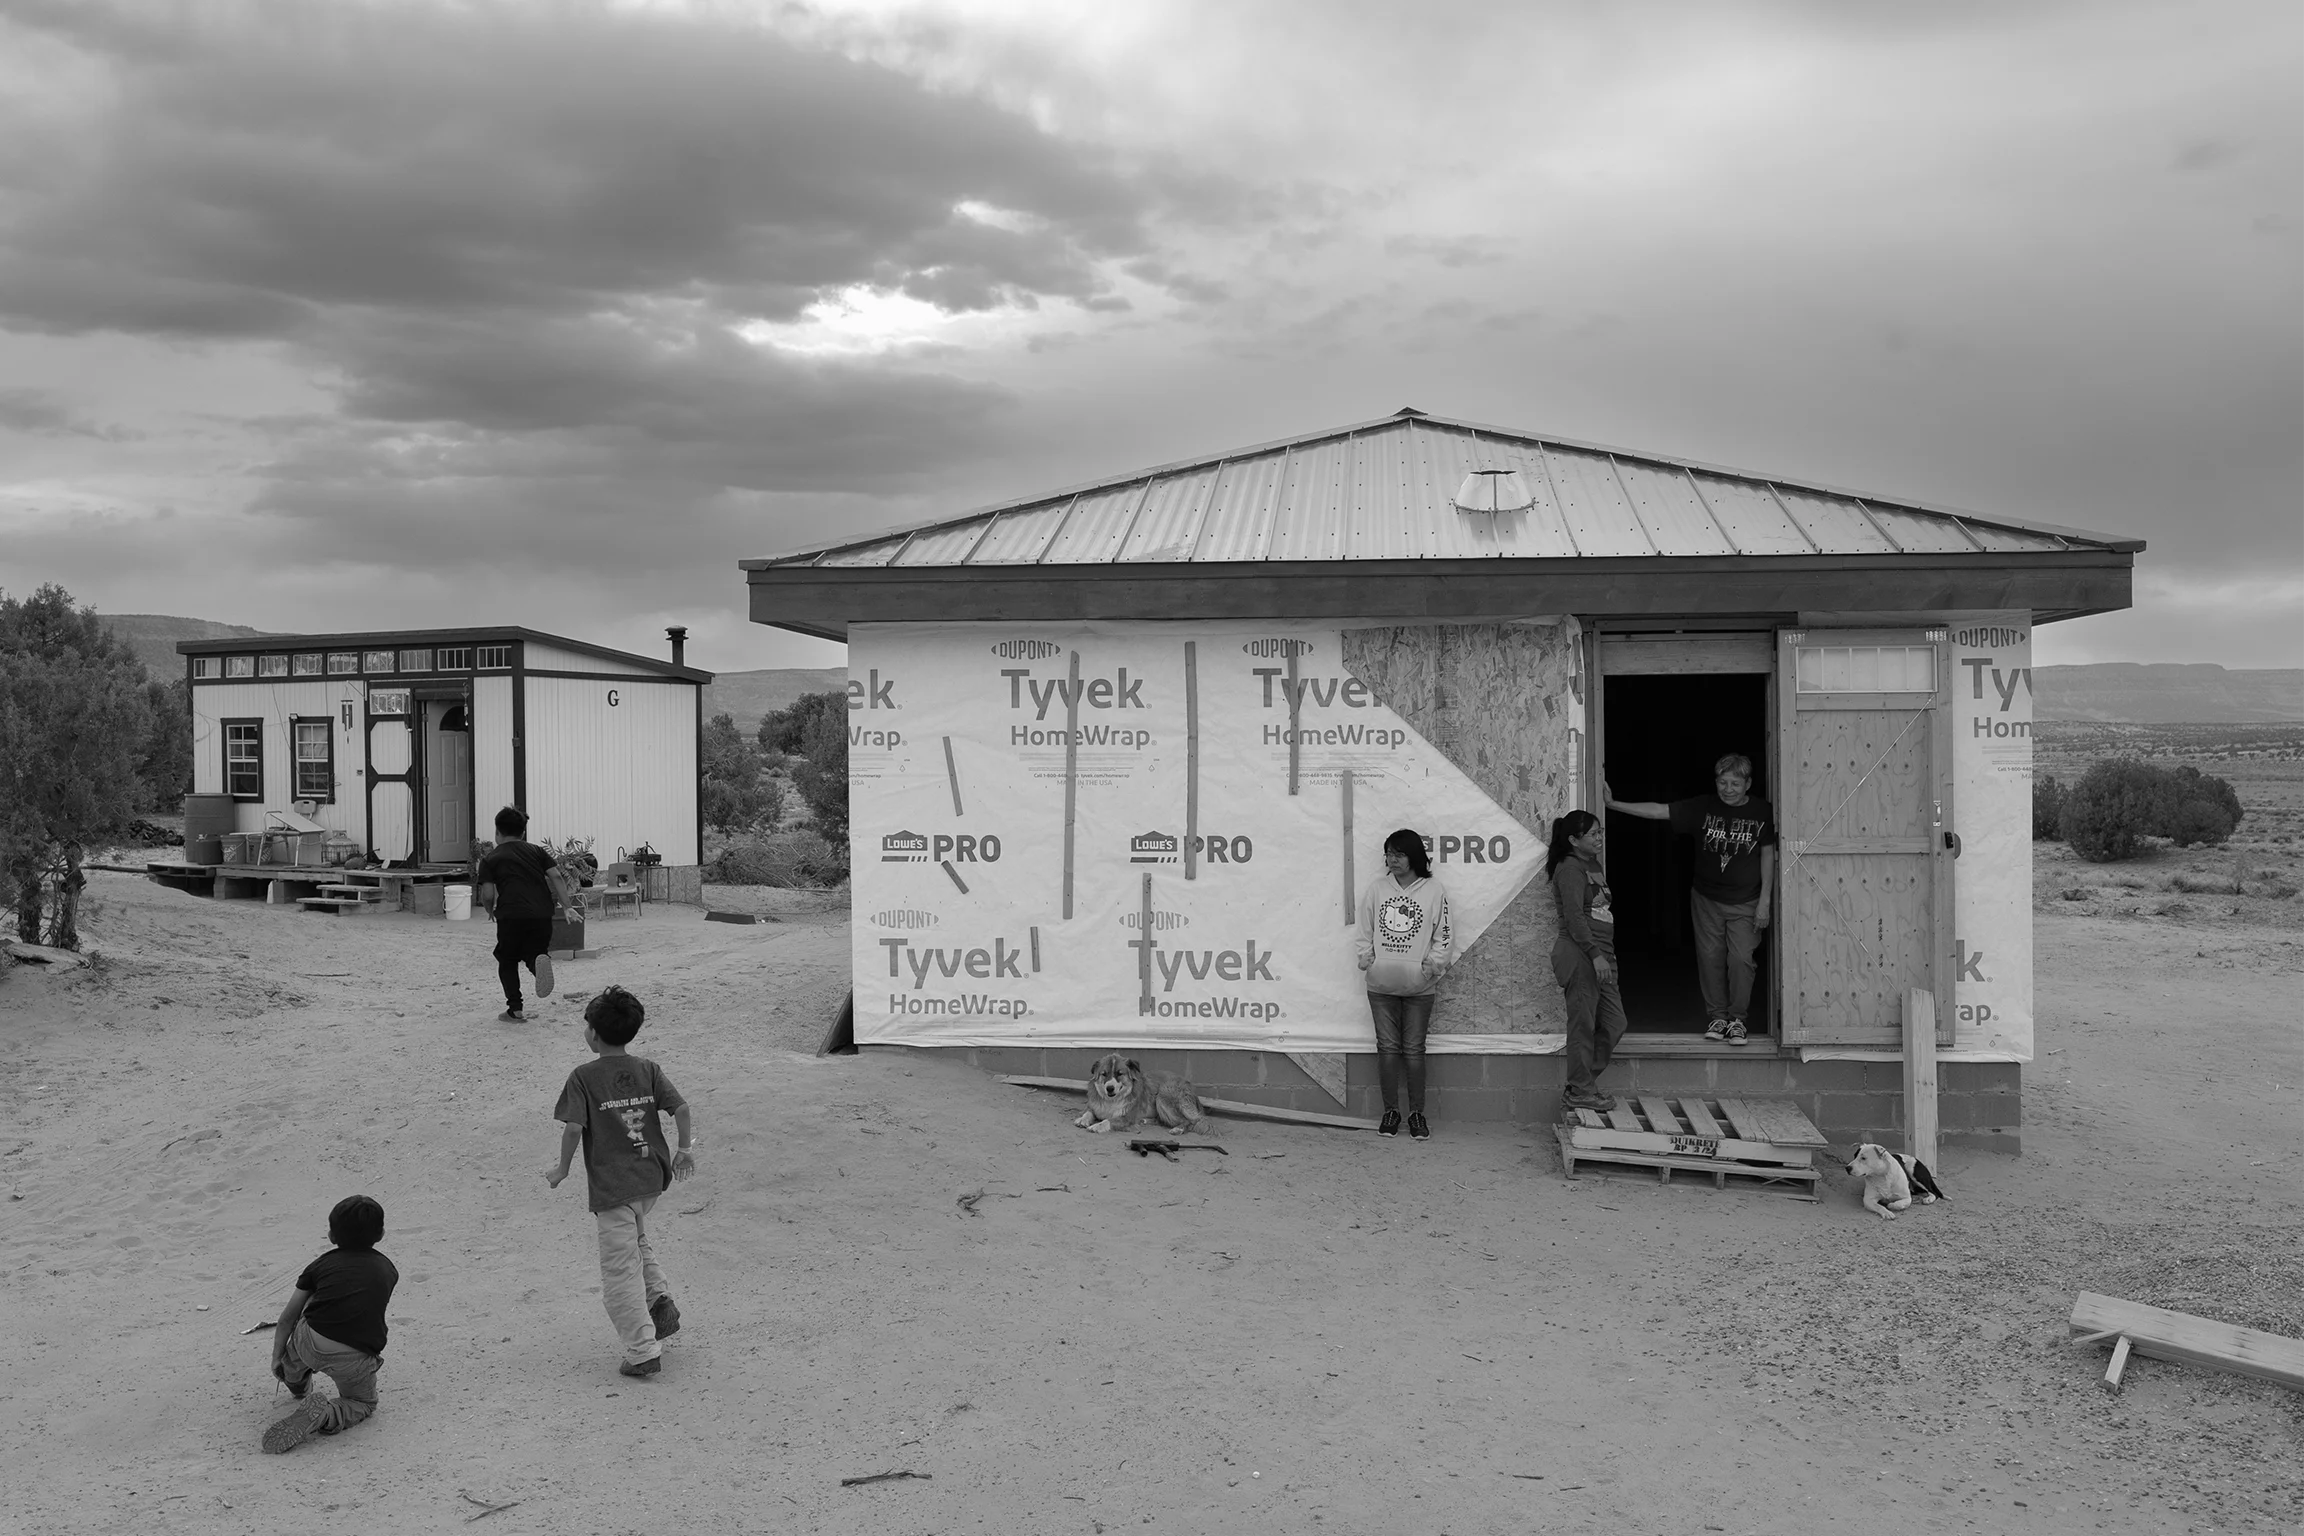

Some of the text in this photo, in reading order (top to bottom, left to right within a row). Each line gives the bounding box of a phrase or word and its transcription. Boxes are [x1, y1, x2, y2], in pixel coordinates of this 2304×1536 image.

[1960, 628, 2018, 648] DUPONT
[1000, 640, 1053, 660] DUPONT
[608, 690, 619, 706] G
[1135, 839, 1173, 850] LOWE'S
[1707, 828, 1753, 841] FOR THE
[887, 835, 1001, 862] LOWE'S PRO
[1440, 835, 1511, 863] PRO
[879, 910, 932, 929] DUPONT
[879, 938, 1022, 989] Tyvek
[1128, 940, 1274, 992] Tyvek
[890, 994, 1028, 1019] HomeWrap
